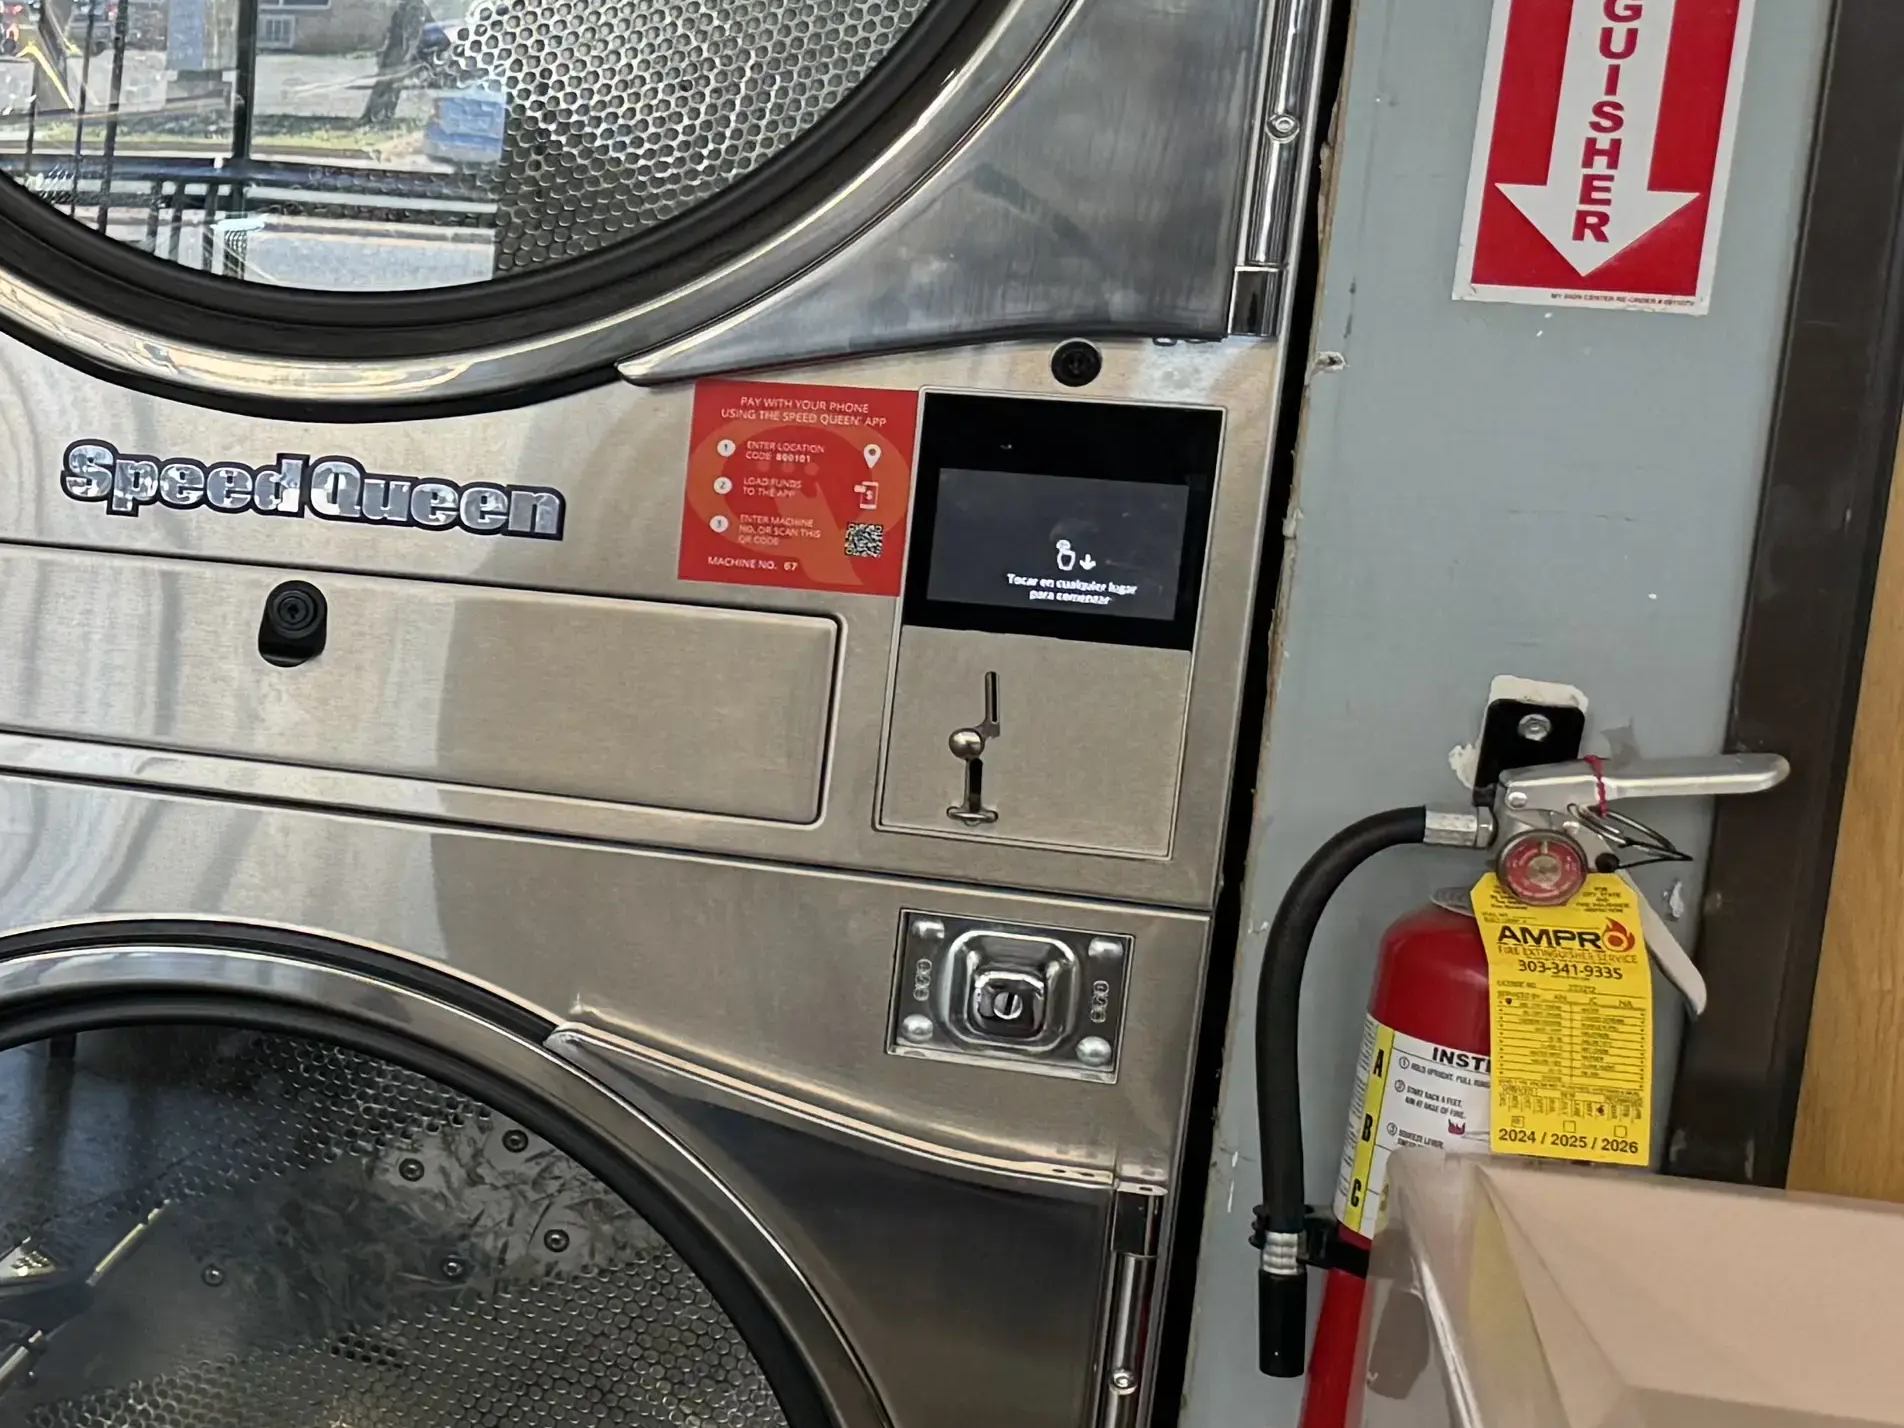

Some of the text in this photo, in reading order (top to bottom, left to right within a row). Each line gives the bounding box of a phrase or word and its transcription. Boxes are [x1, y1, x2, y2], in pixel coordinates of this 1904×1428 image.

[740, 396, 869, 414] PAY WITH YOUR PHONE
[721, 408, 756, 420] USING
[759, 410, 779, 421] THE
[782, 411, 817, 423] SPEED
[864, 417, 887, 427] APP
[747, 440, 775, 451] ENTER
[777, 442, 825, 453] LOCATION
[745, 452, 811, 463] CODE 800101
[743, 476, 769, 486] LOAD
[770, 478, 802, 489] FUNDS
[743, 487, 796, 498] TO THE APP
[740, 514, 769, 524] ENTER
[770, 516, 814, 528] MACHINE
[753, 536, 780, 545] CODE
[759, 527, 772, 535] OR
[774, 527, 799, 537] SCAN
[800, 529, 821, 538] THIS
[708, 556, 756, 569] MACHINE
[783, 562, 798, 571] 67
[1498, 946, 1638, 964] FIRE EXTINGUISHER SERVICE
[1518, 959, 1623, 980] 303-341-9335
[1373, 1049, 1384, 1078] A
[1361, 1113, 1373, 1142] B
[1498, 1128, 1537, 1144] 2024
[1551, 1133, 1588, 1148] 2025
[1601, 1138, 1639, 1154] 2026
[1350, 1178, 1361, 1208] C
